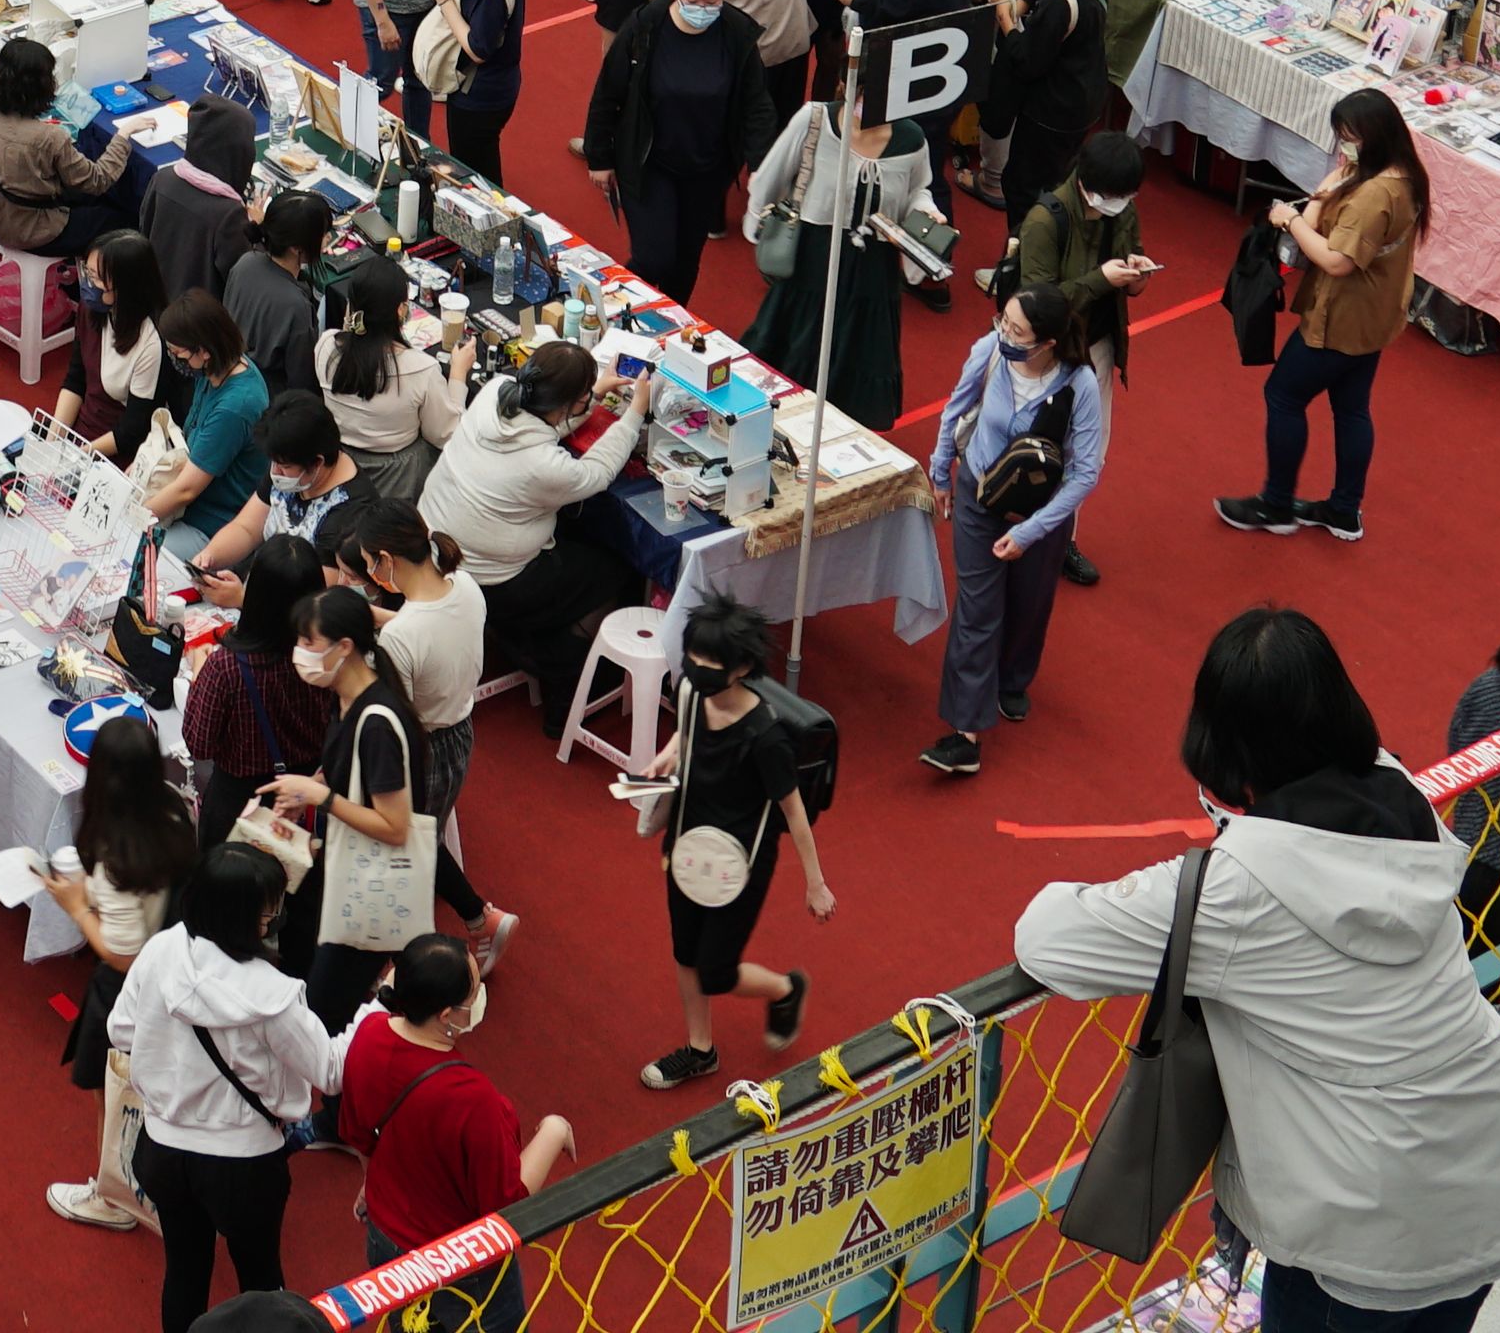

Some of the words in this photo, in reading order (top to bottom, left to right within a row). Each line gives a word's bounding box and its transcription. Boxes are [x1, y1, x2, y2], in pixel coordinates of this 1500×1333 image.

[885, 27, 969, 122] B
[1434, 761, 1464, 793] OR
[745, 1097, 972, 1240] 勿倚靠及攀爬
[746, 1051, 974, 1197] 請勿重壓欄杆
[318, 1282, 381, 1326] YUR
[376, 1254, 433, 1300] OWN
